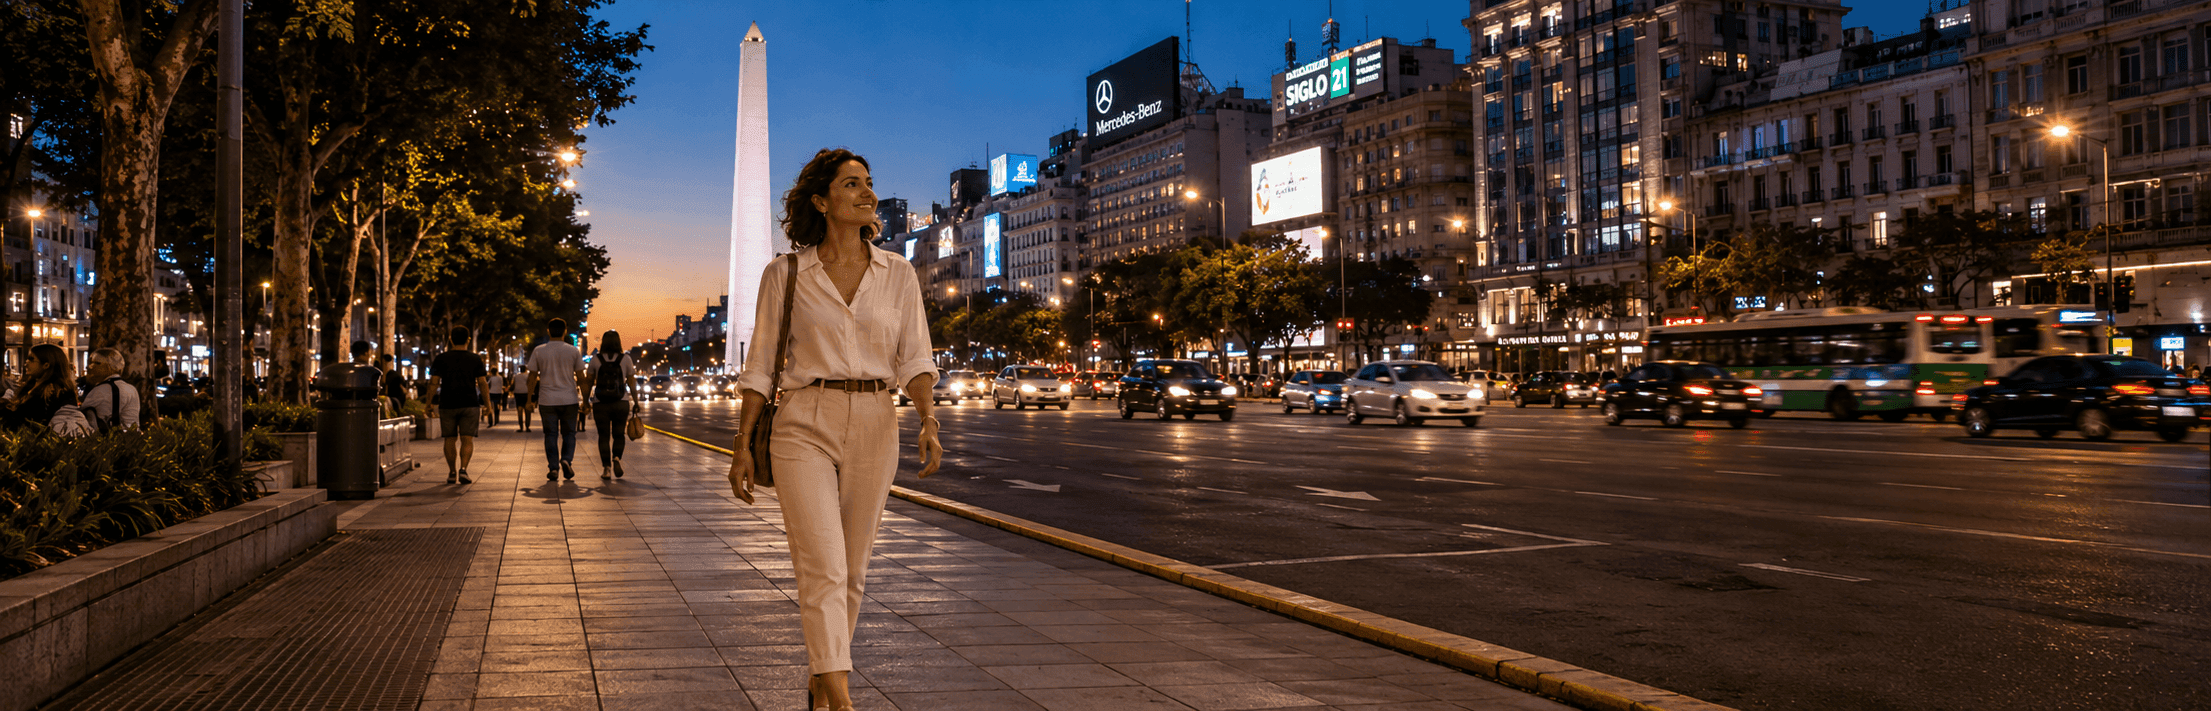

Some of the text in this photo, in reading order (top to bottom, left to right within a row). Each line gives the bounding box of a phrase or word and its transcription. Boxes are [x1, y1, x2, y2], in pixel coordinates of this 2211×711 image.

[1286, 74, 1328, 106] SIGLO
[1332, 66, 1347, 92] 21
[1096, 100, 1162, 136] Mercedes-Benz
